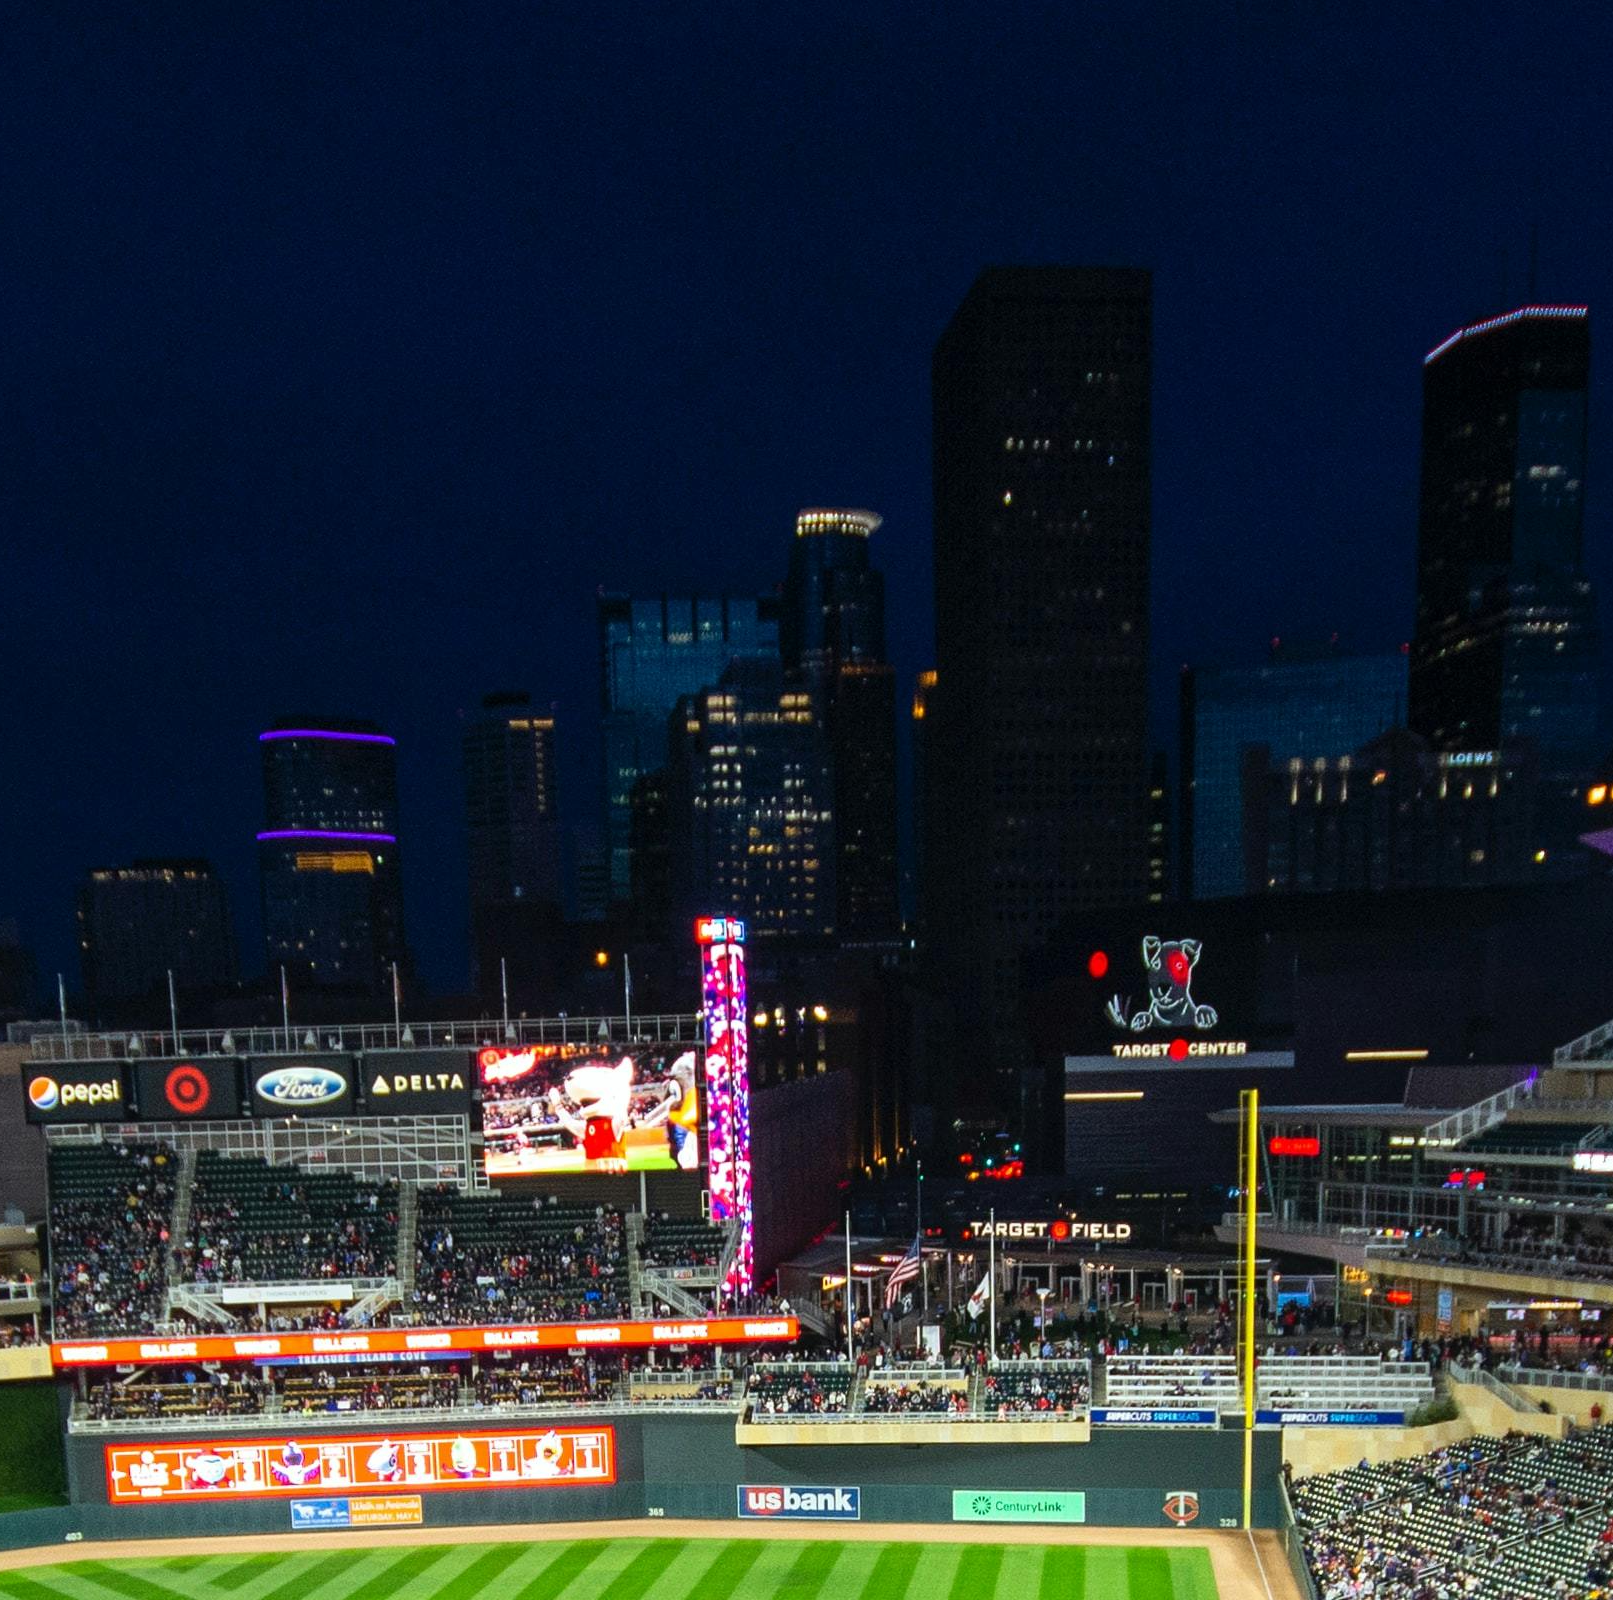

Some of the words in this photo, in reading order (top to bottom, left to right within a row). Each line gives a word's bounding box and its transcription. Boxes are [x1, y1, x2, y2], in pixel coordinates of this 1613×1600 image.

[1450, 751, 1493, 764] LOEWS
[1112, 1043, 1170, 1057] TARGET
[1187, 1042, 1247, 1055] CENTER
[274, 1070, 328, 1099] Ford
[393, 1073, 464, 1092] DELTA
[60, 1078, 120, 1106] pepsi
[970, 1222, 1048, 1237] TARGET
[1071, 1223, 1131, 1238] FIELD
[298, 1354, 351, 1365] TREASURE
[356, 1353, 393, 1362] ISLAND
[400, 1351, 427, 1361] COVE
[1105, 1411, 1152, 1422] SUPERCUTS
[1153, 1411, 1200, 1423] SUPERSEATS
[1281, 1411, 1328, 1423] SUPERCUTS
[1329, 1412, 1379, 1424] SUPERSEATS
[995, 1500, 1062, 1514] CenturyLink
[1219, 1518, 1237, 1528] 328
